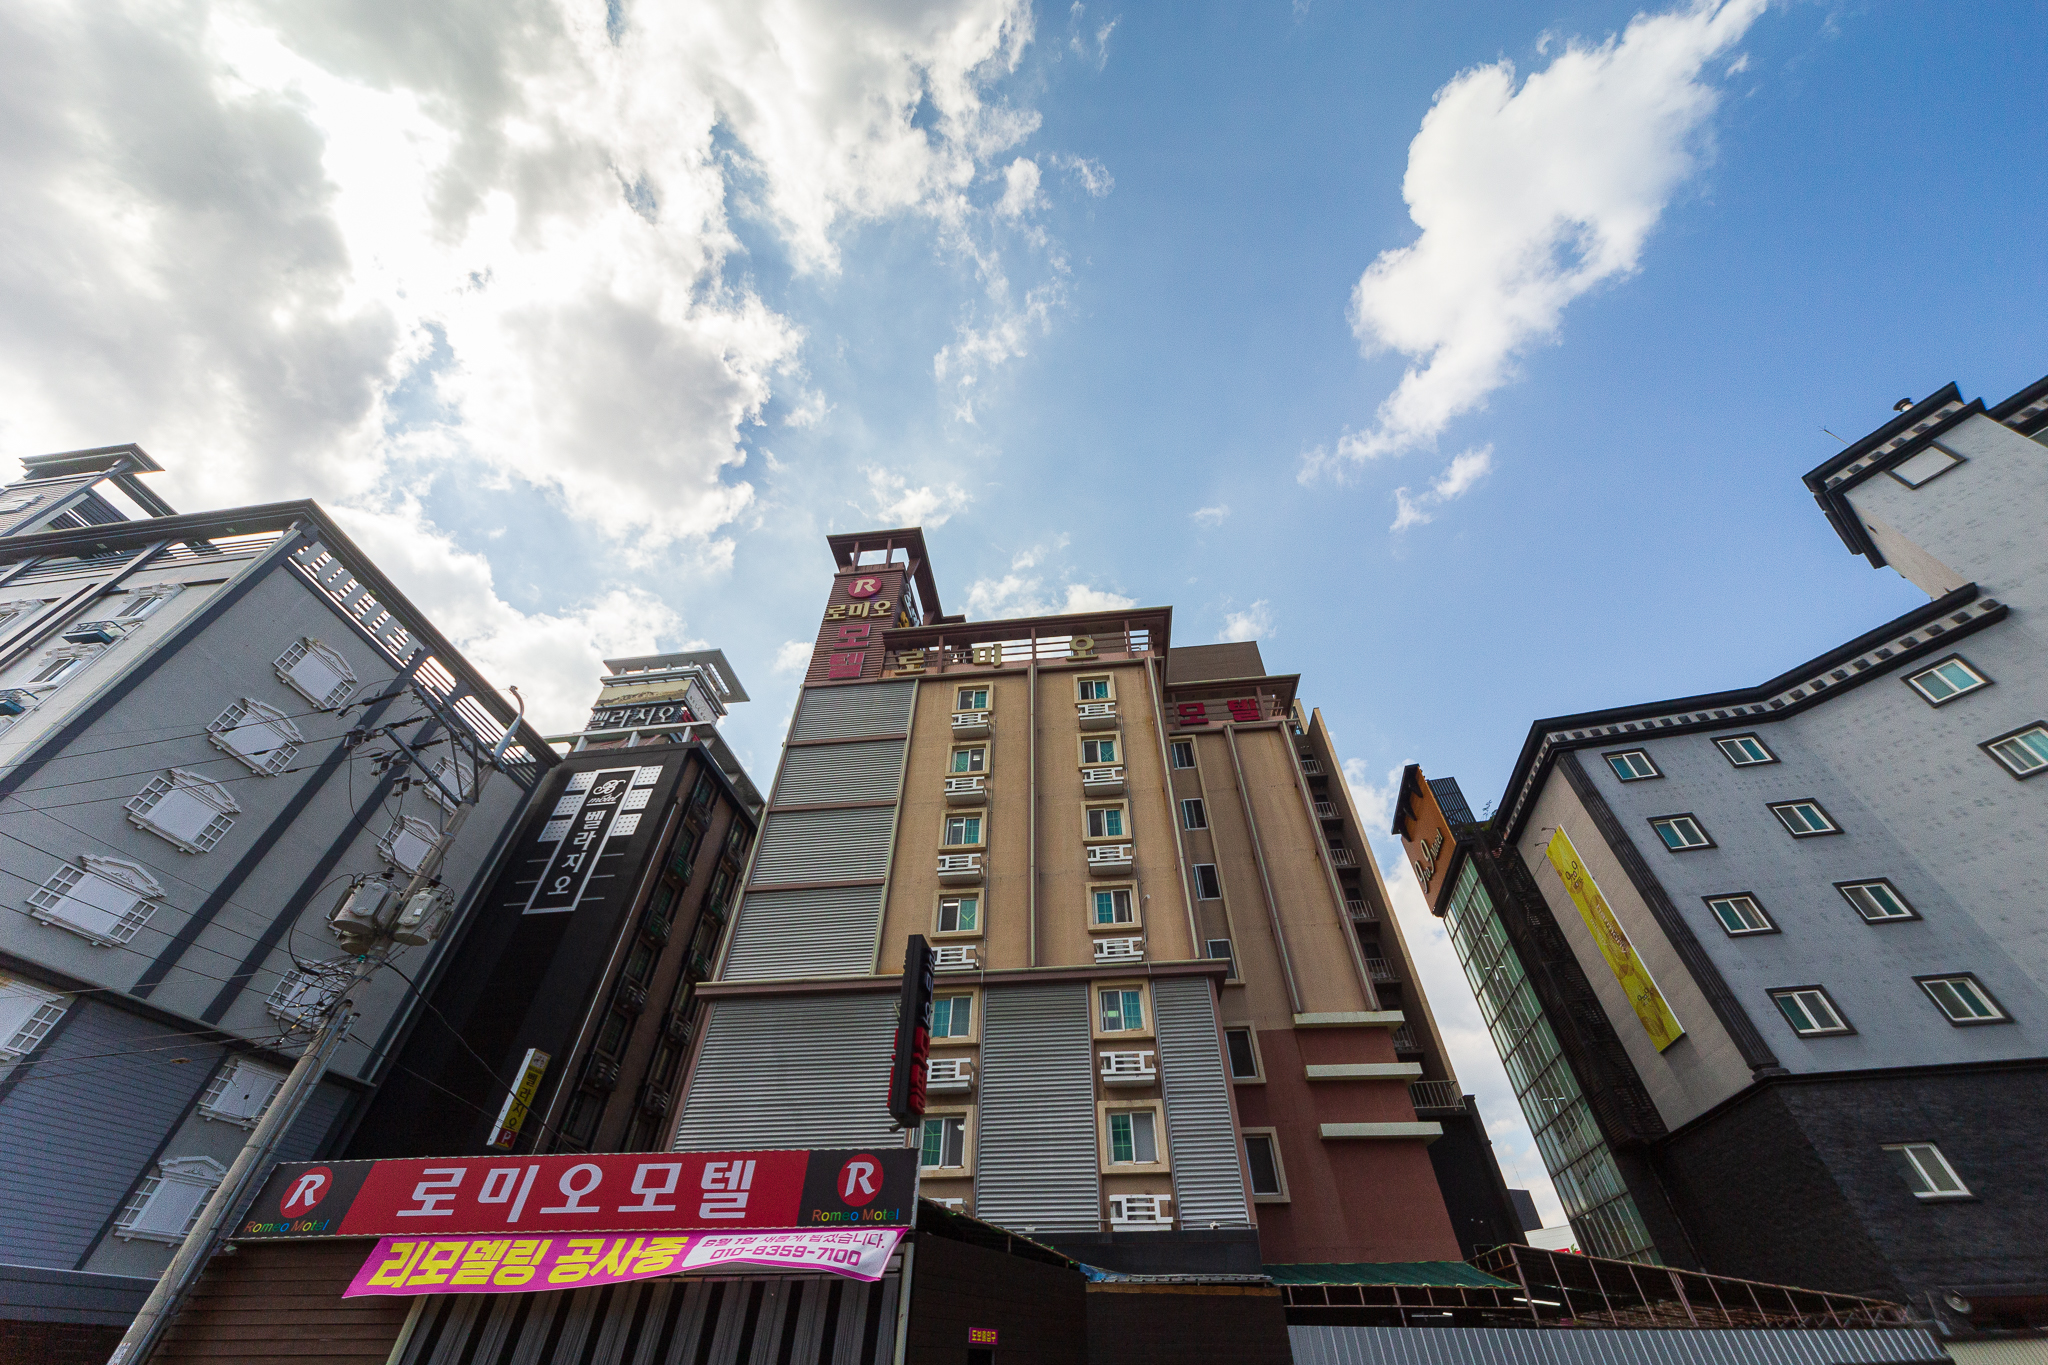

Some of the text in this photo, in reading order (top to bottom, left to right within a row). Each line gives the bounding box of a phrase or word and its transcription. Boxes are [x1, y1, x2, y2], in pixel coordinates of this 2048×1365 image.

[854, 579, 876, 594] R
[292, 541, 425, 668] JULIET
[824, 601, 891, 620] 로미오
[828, 623, 871, 679] 모텔
[894, 636, 1099, 677] 로미오
[586, 706, 675, 731] 벨라지오
[1178, 699, 1261, 726] 모텔
[547, 810, 607, 895] 벨라지오
[505, 1072, 538, 1130] 벨라지오
[501, 1131, 512, 1143] P
[285, 1174, 326, 1209] R
[844, 1161, 875, 1197] R
[243, 1219, 330, 1233] Romeo Motel
[812, 1208, 900, 1222] Romeo Motel
[734, 1236, 759, 1245] 1일
[367, 1236, 689, 1288] 리모델링 공사중
[709, 1245, 862, 1267] 010-8359-7100
